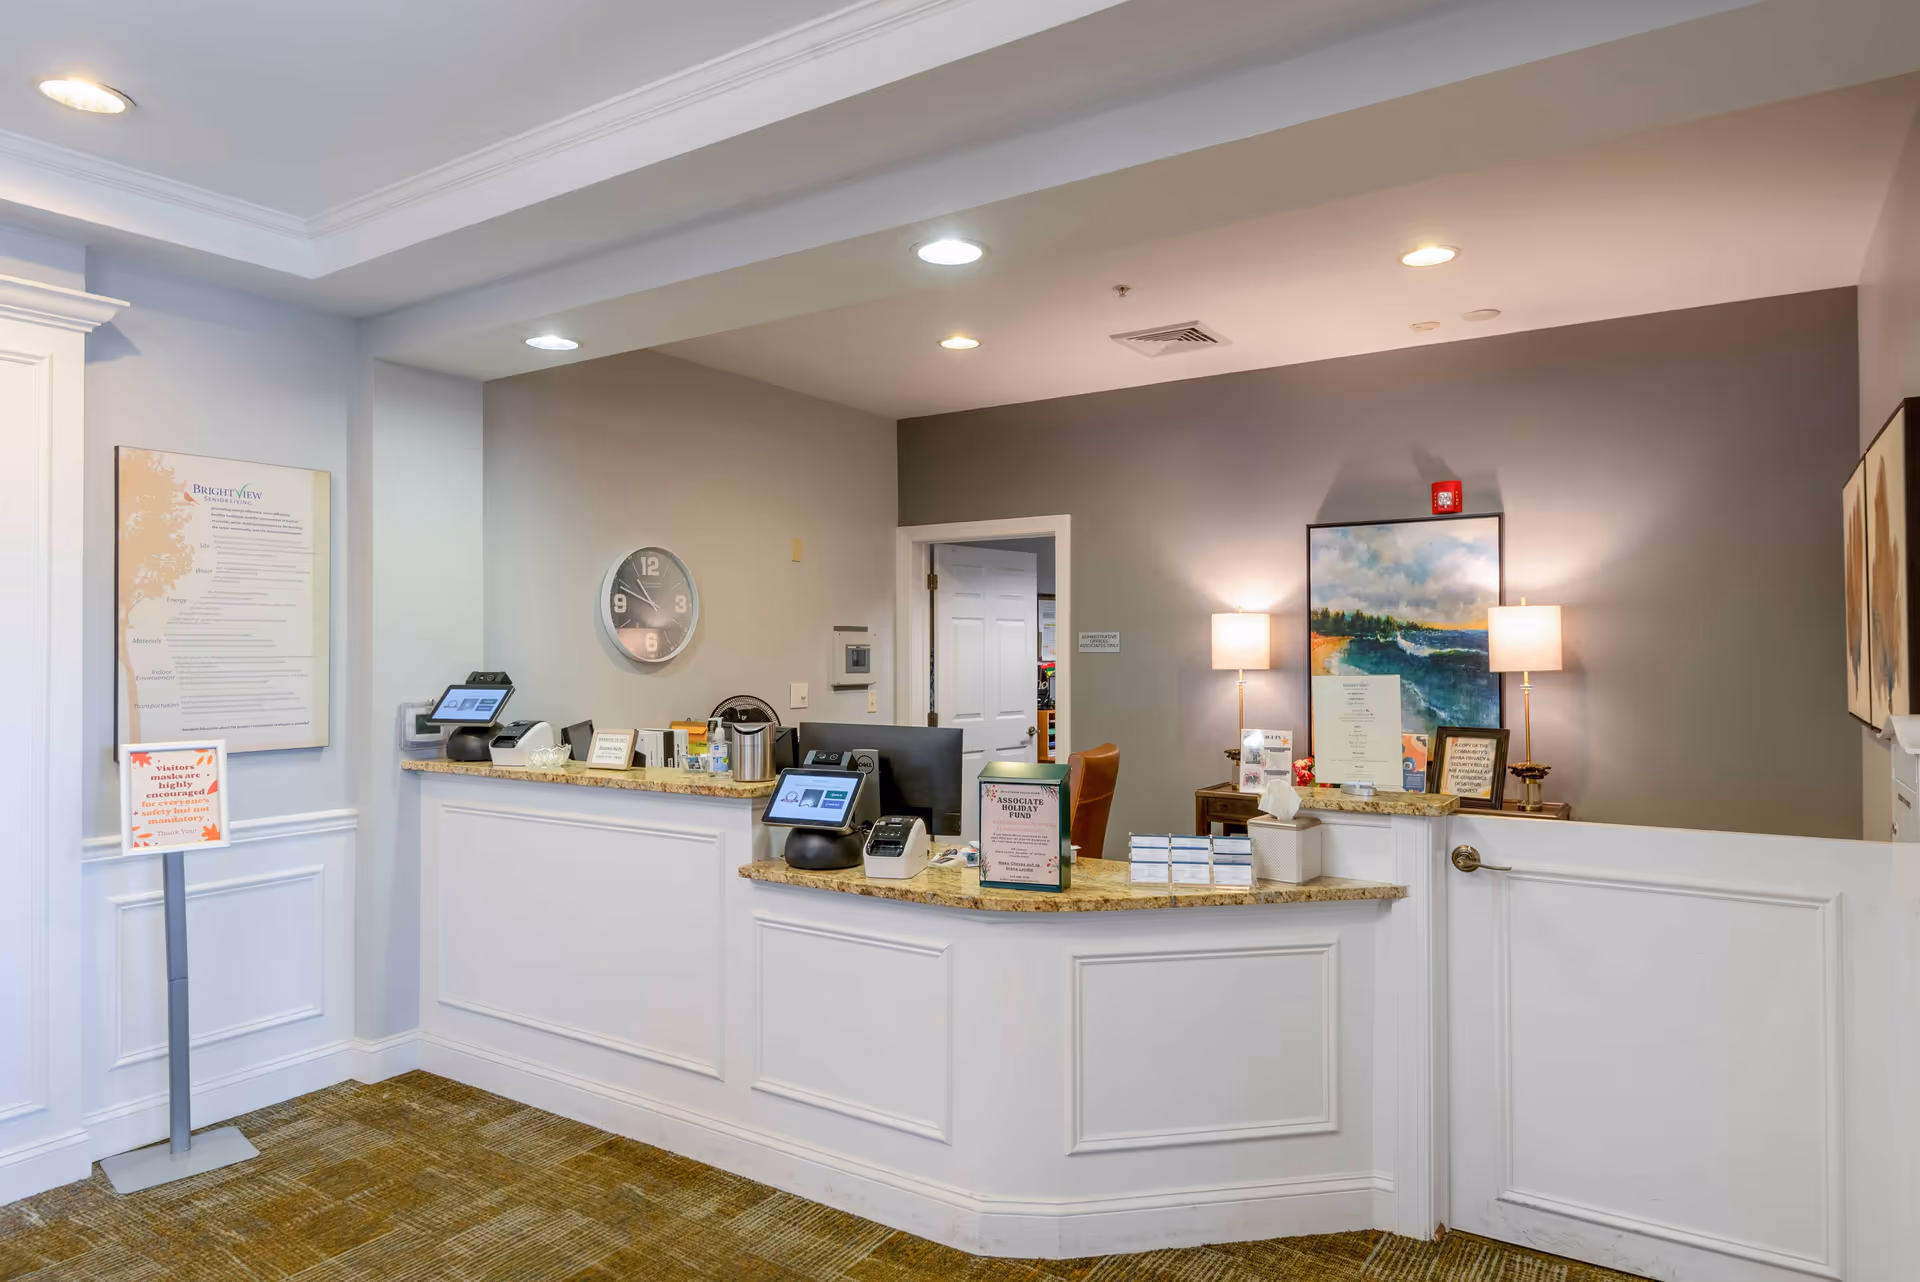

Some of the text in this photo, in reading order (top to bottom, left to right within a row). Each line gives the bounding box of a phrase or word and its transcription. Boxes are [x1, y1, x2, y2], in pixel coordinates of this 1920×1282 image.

[204, 496, 228, 504] SENIOR
[641, 556, 660, 576] 12
[166, 596, 186, 604] Energy
[614, 594, 626, 613] 9
[674, 595, 686, 613] 3
[646, 632, 658, 652] 6
[158, 781, 193, 789] highly
[146, 789, 205, 798] encouraged
[158, 798, 209, 806] everyone's
[997, 797, 1044, 806] ASSOCIATE
[148, 815, 204, 824] mandatory
